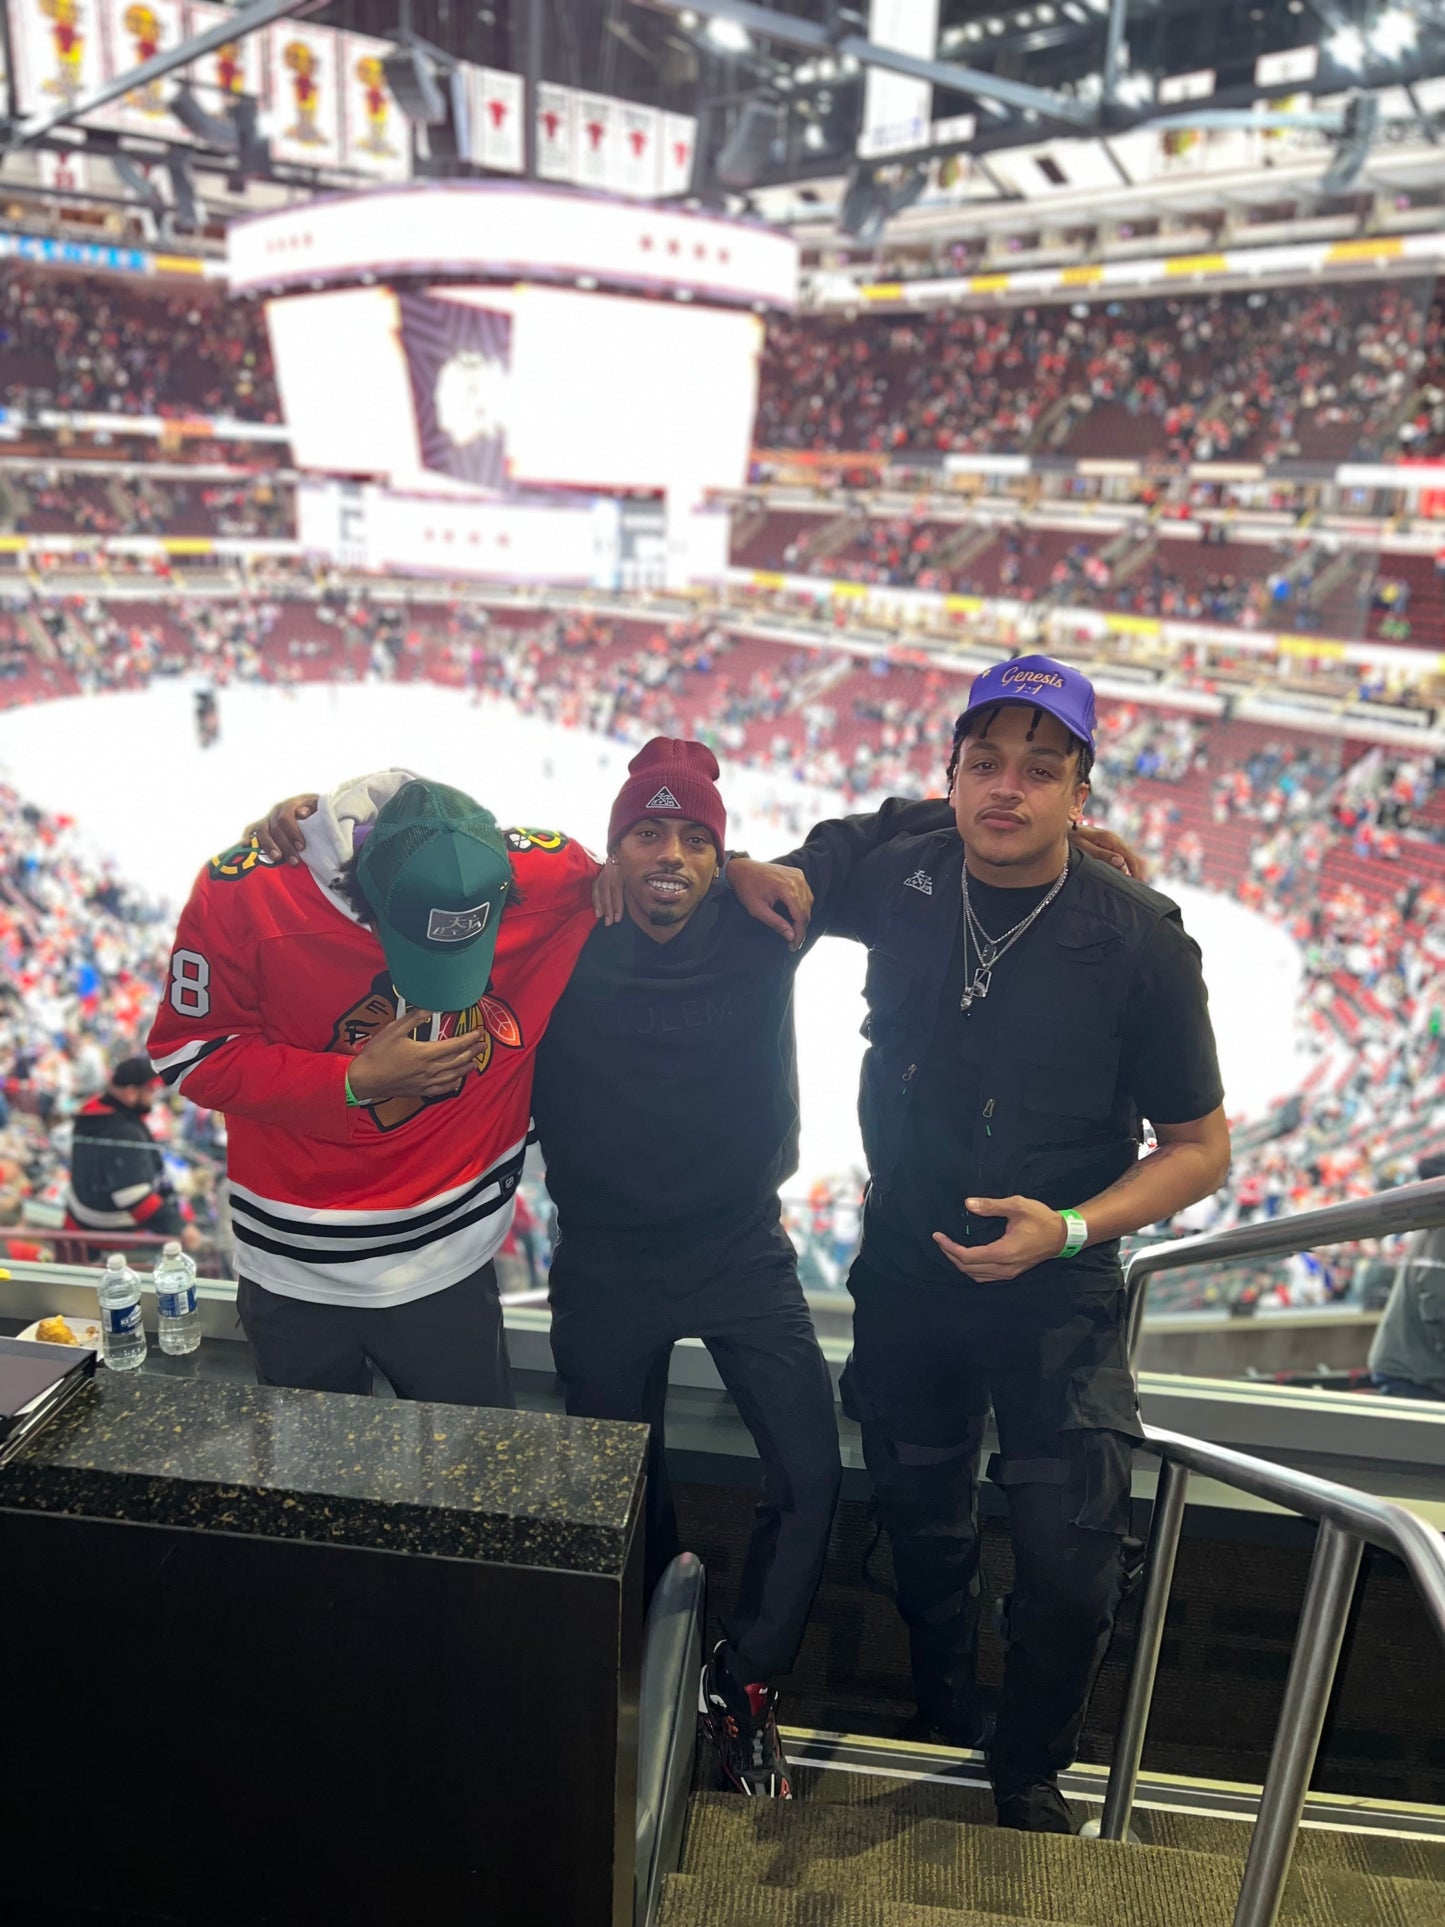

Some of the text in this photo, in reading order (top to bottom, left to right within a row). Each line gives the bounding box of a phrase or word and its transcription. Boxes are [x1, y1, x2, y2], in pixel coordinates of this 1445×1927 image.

[1002, 666, 1065, 689] Genesis
[1015, 683, 1043, 695] 1:1
[160, 948, 211, 1019] 8
